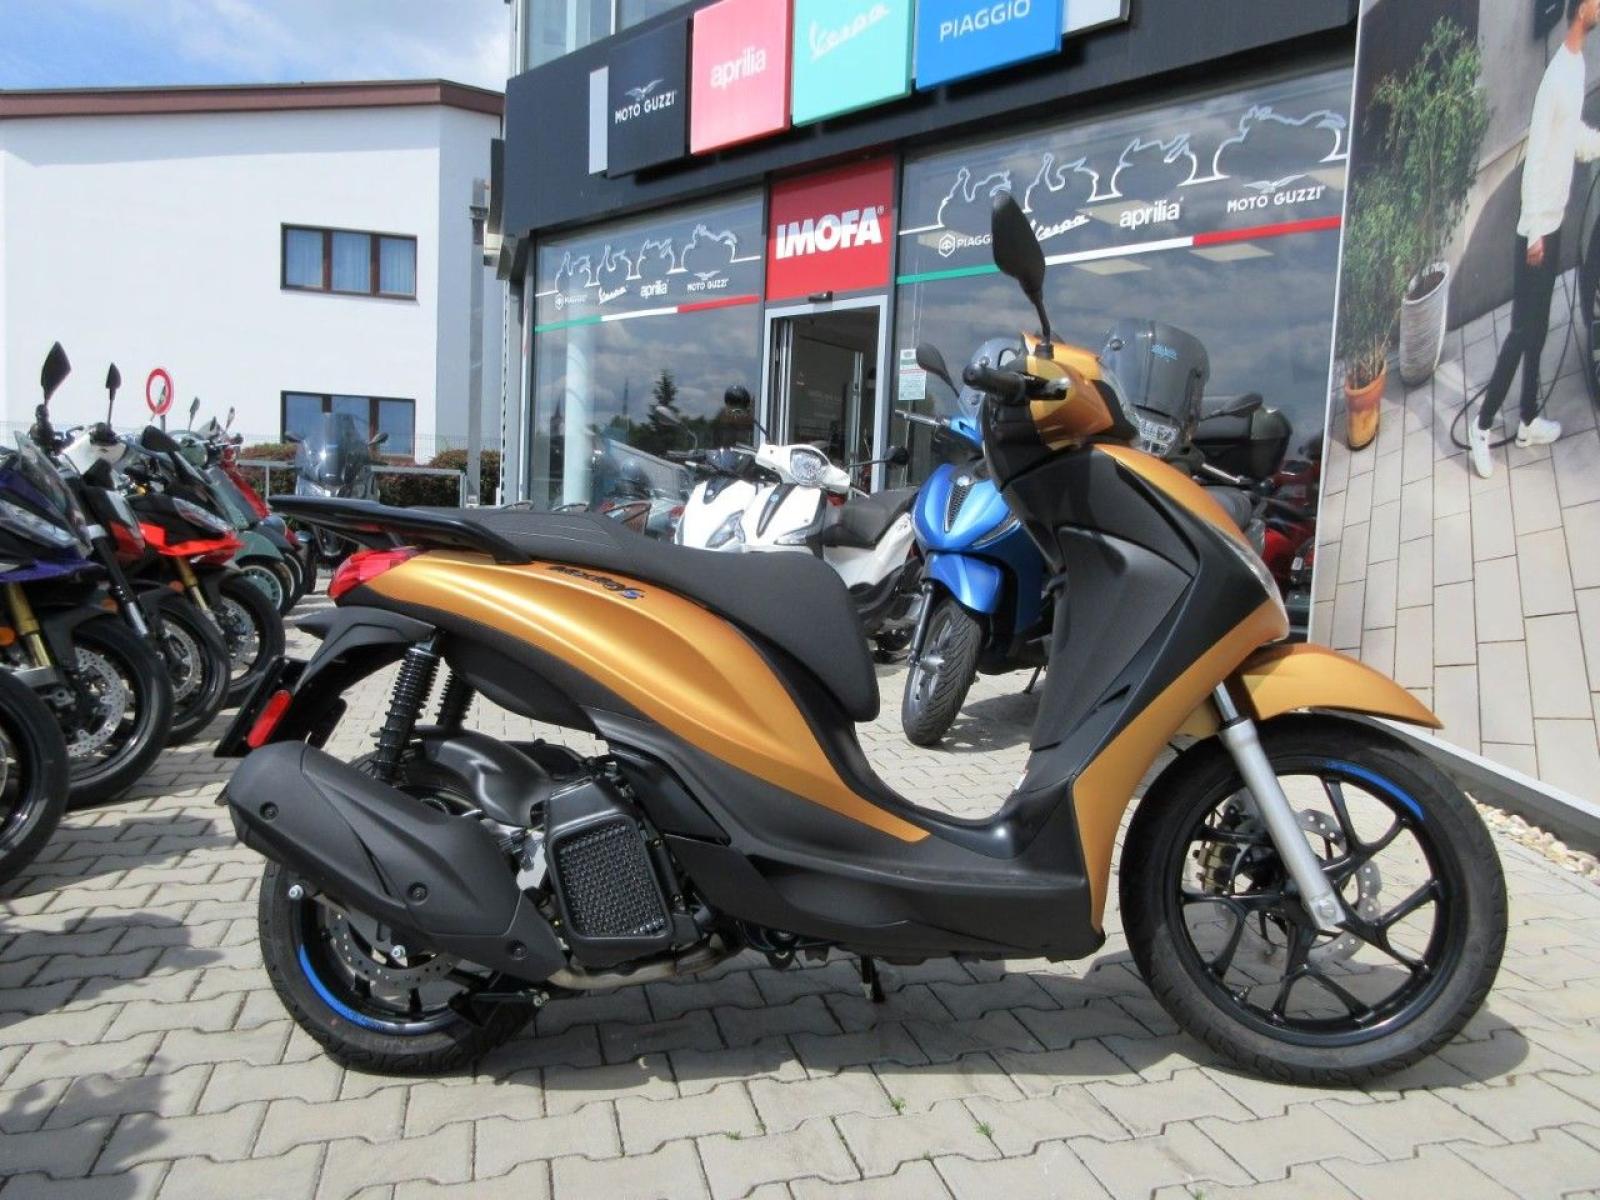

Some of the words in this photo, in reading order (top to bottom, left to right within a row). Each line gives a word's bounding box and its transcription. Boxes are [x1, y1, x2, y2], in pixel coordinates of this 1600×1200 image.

[808, 3, 889, 63] Vespa
[940, 0, 1031, 41] PIAGGIO
[710, 46, 767, 90] aprilia
[614, 103, 641, 124] MOTO
[644, 90, 675, 113] GUZZI
[957, 234, 994, 248] PIAGG
[1119, 199, 1181, 230] aprilia
[1226, 195, 1268, 214] MOTO
[1273, 187, 1320, 206] GUZZI
[641, 280, 668, 300] aprilia
